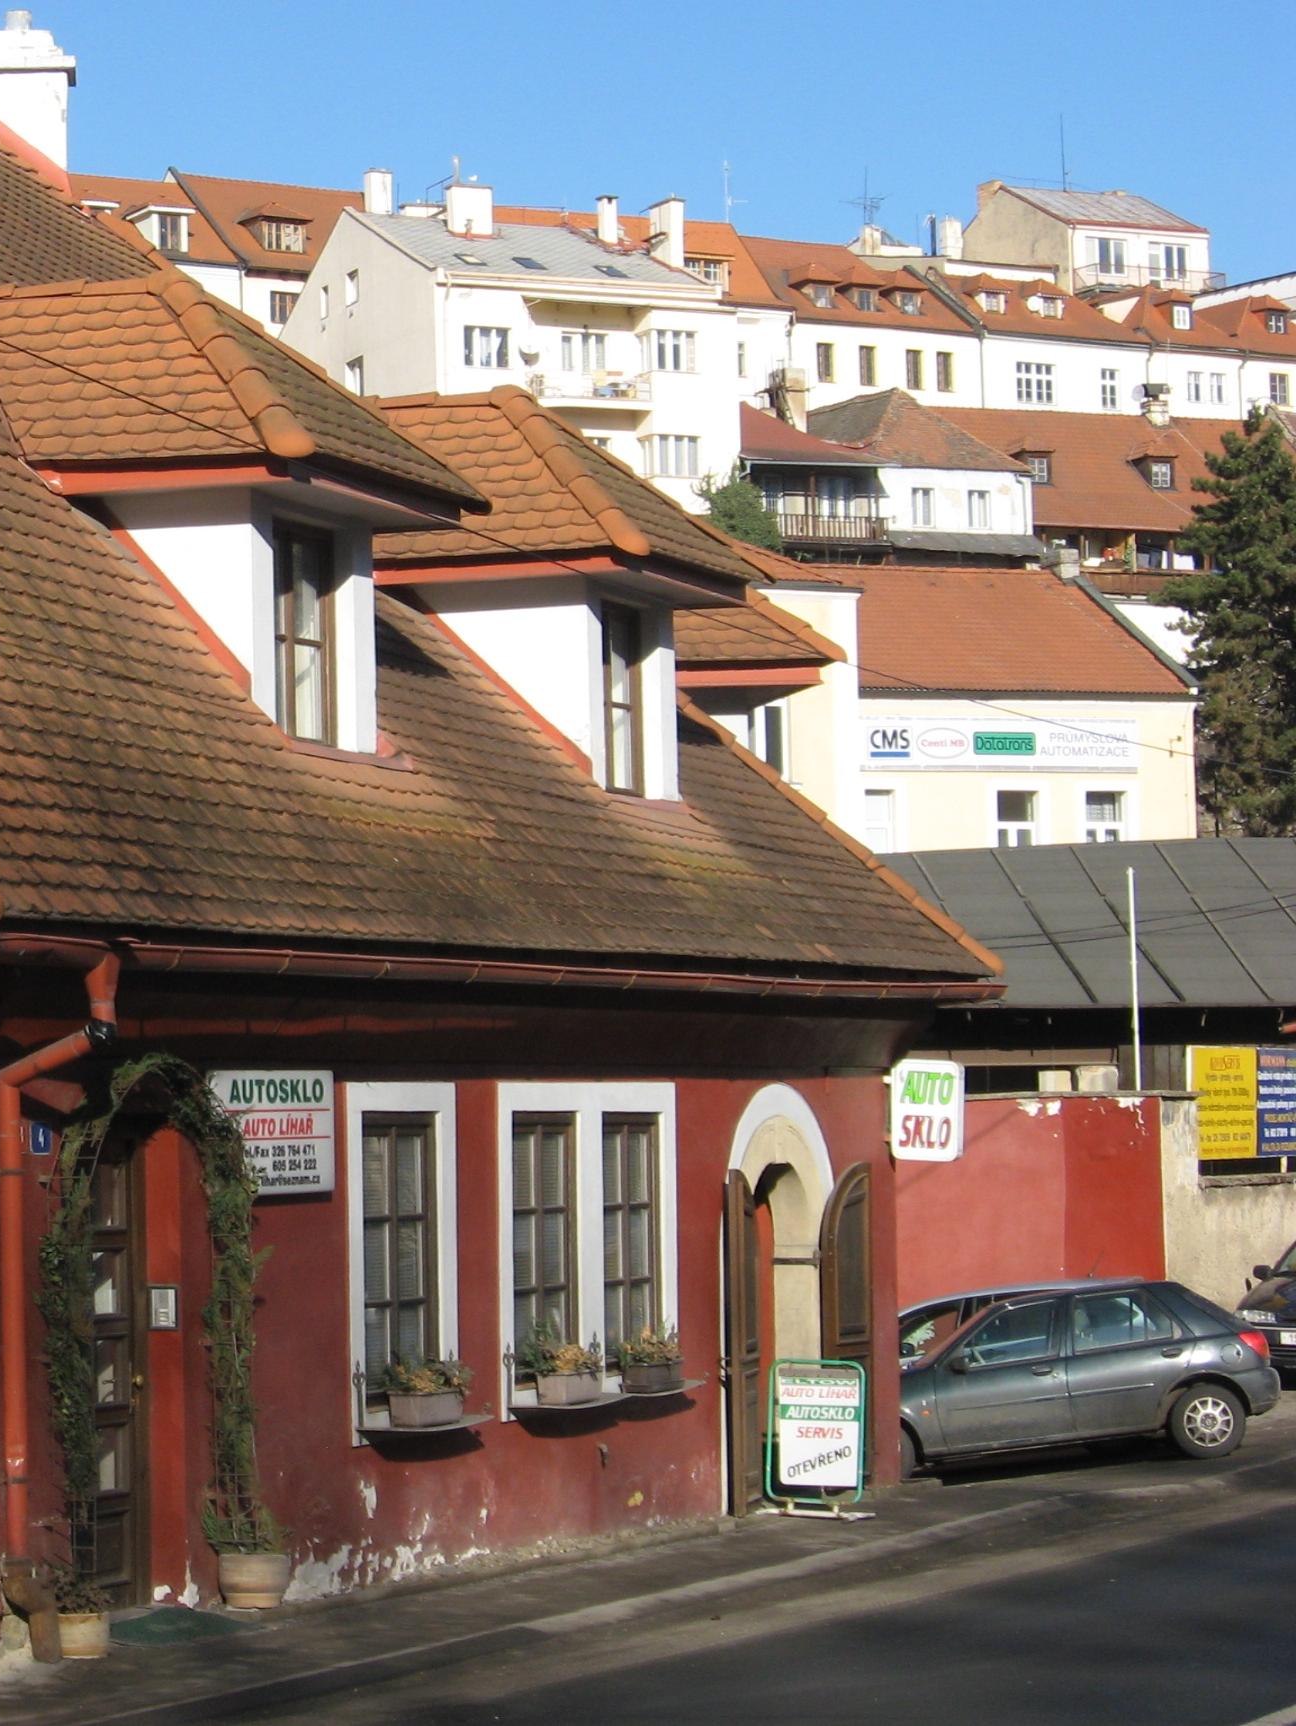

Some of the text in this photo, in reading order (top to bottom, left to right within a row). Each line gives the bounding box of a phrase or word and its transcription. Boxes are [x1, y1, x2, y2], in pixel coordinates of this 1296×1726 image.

[870, 729, 911, 750] CMS
[975, 735, 1034, 752] Datatrans
[1040, 745, 1130, 757] AUTOMATIZACE
[229, 1078, 324, 1105] AUTOSKLO
[900, 1071, 954, 1105] AUTO
[243, 1113, 314, 1137] AUTO LÍHAŘ
[899, 1115, 952, 1149] SKLO
[38, 1128, 45, 1148] 4
[782, 1387, 814, 1398] AUTO
[785, 1406, 855, 1420] AUTOSKLO
[796, 1426, 843, 1439] SERVIS
[786, 1445, 852, 1479] OTEVŘENO
